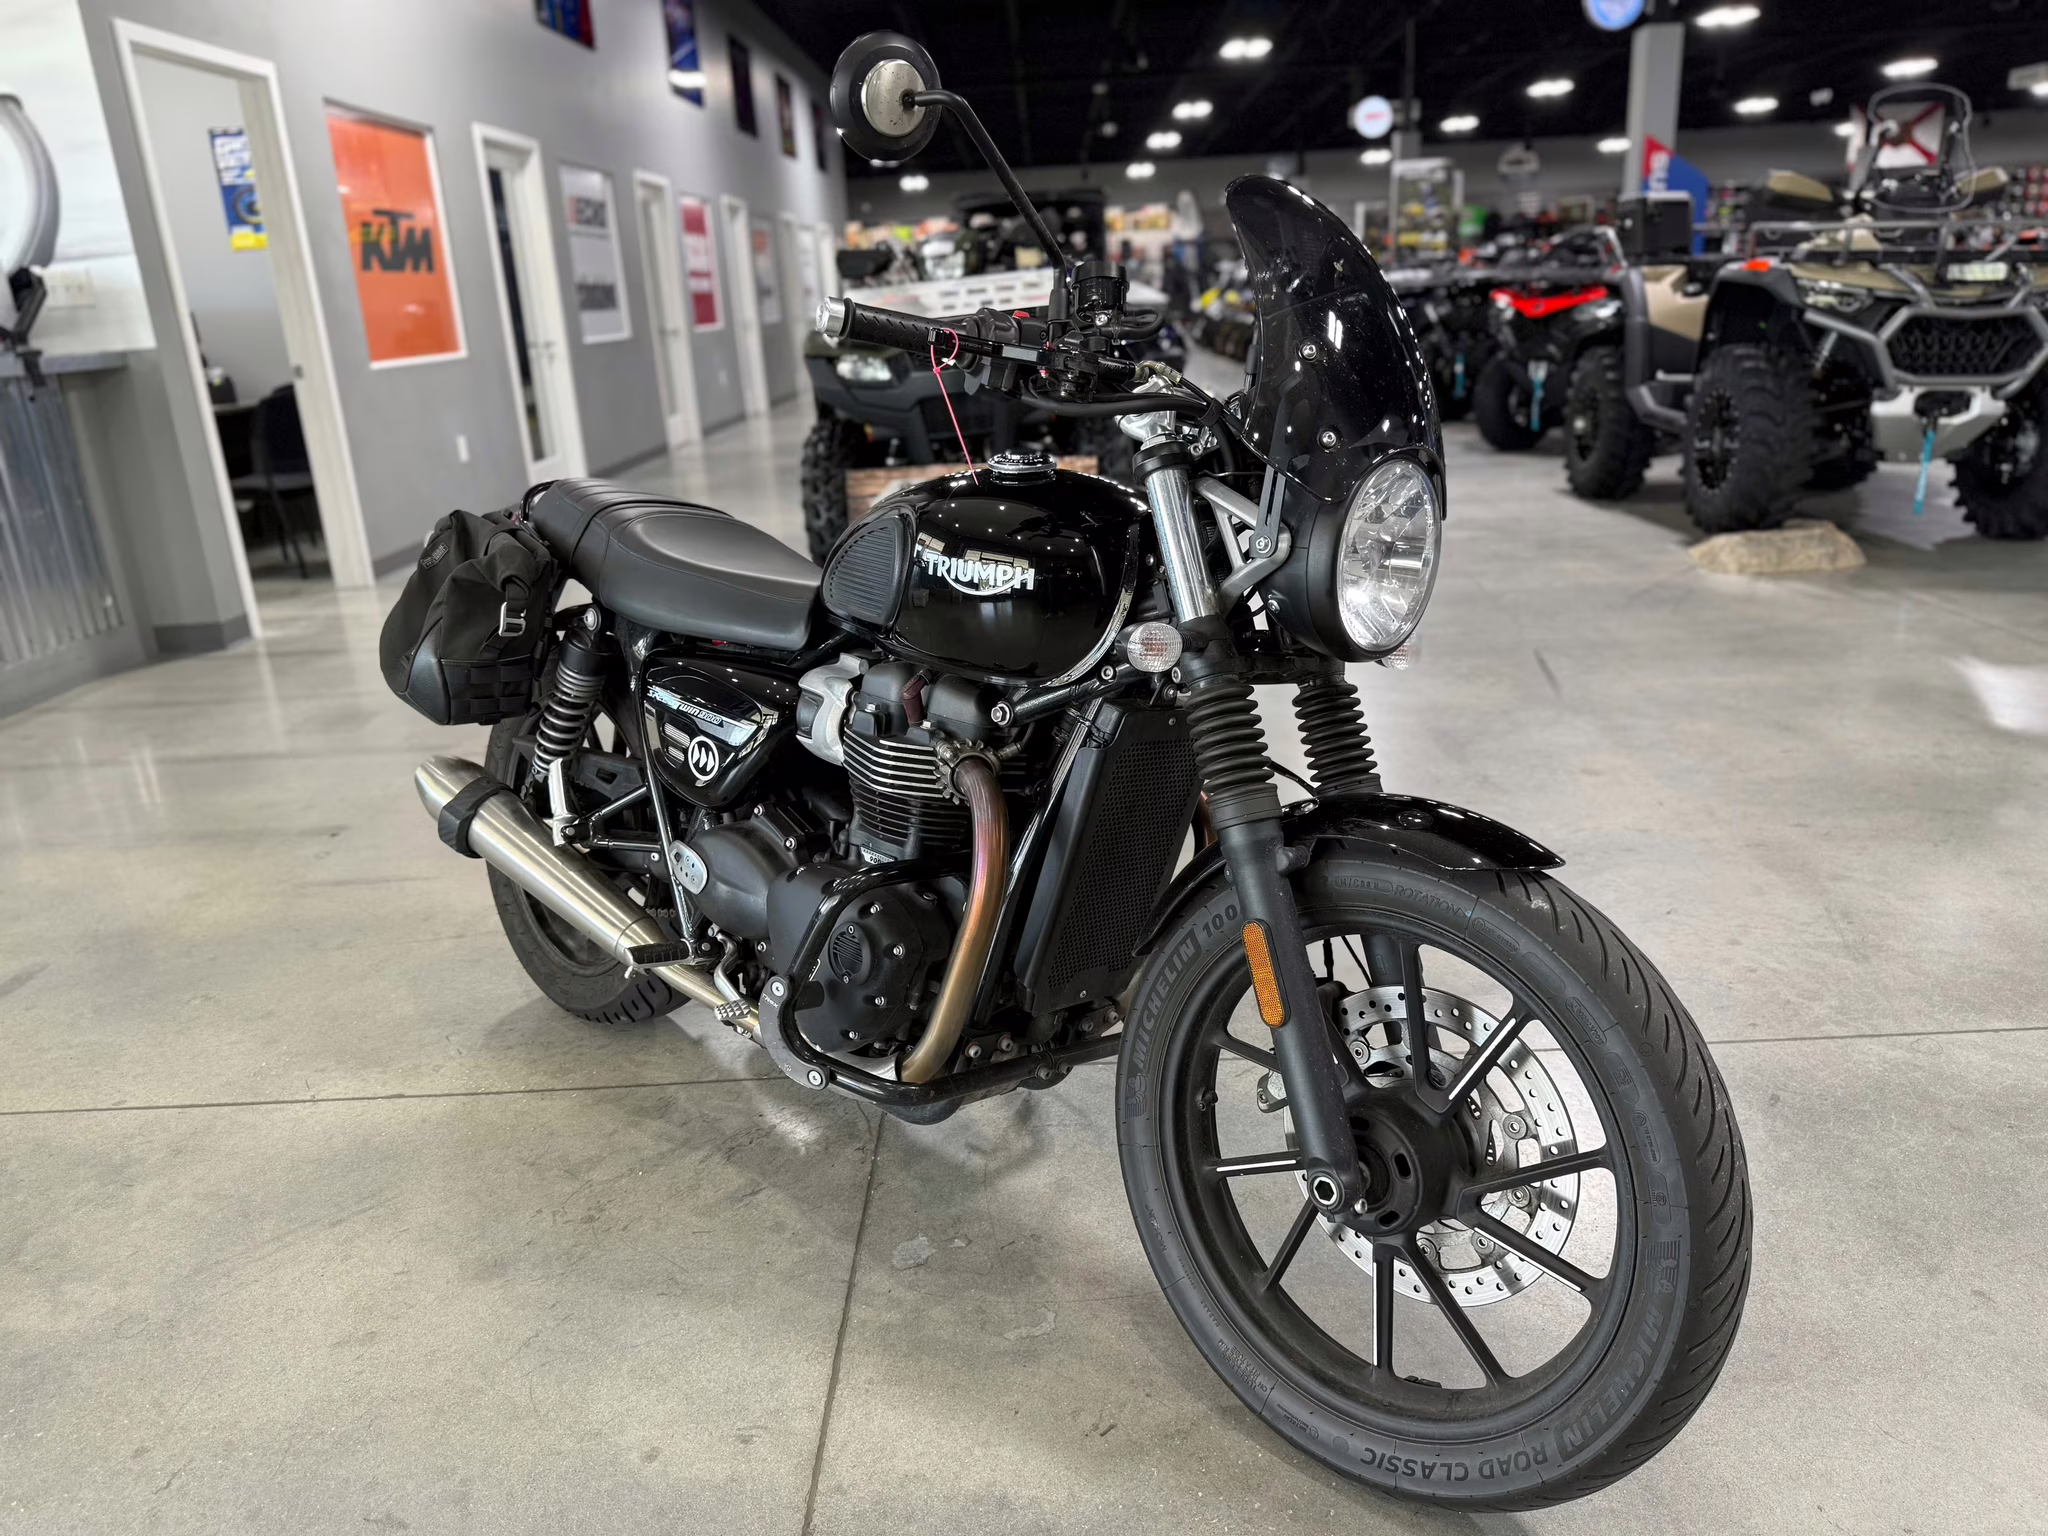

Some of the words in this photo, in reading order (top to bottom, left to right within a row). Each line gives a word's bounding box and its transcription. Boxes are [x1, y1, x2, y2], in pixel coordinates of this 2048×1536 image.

[362, 209, 433, 273] KTM
[926, 554, 1035, 595] TRIUMPH
[697, 710, 722, 725] 900
[1394, 884, 1459, 915] ROTATION
[1202, 904, 1238, 938] 100
[1132, 936, 1196, 1068] MICHELIN
[1563, 1306, 1665, 1452] MICHELIN
[1359, 1446, 1470, 1482] CLASSIC
[1478, 1441, 1549, 1480] ROAD
